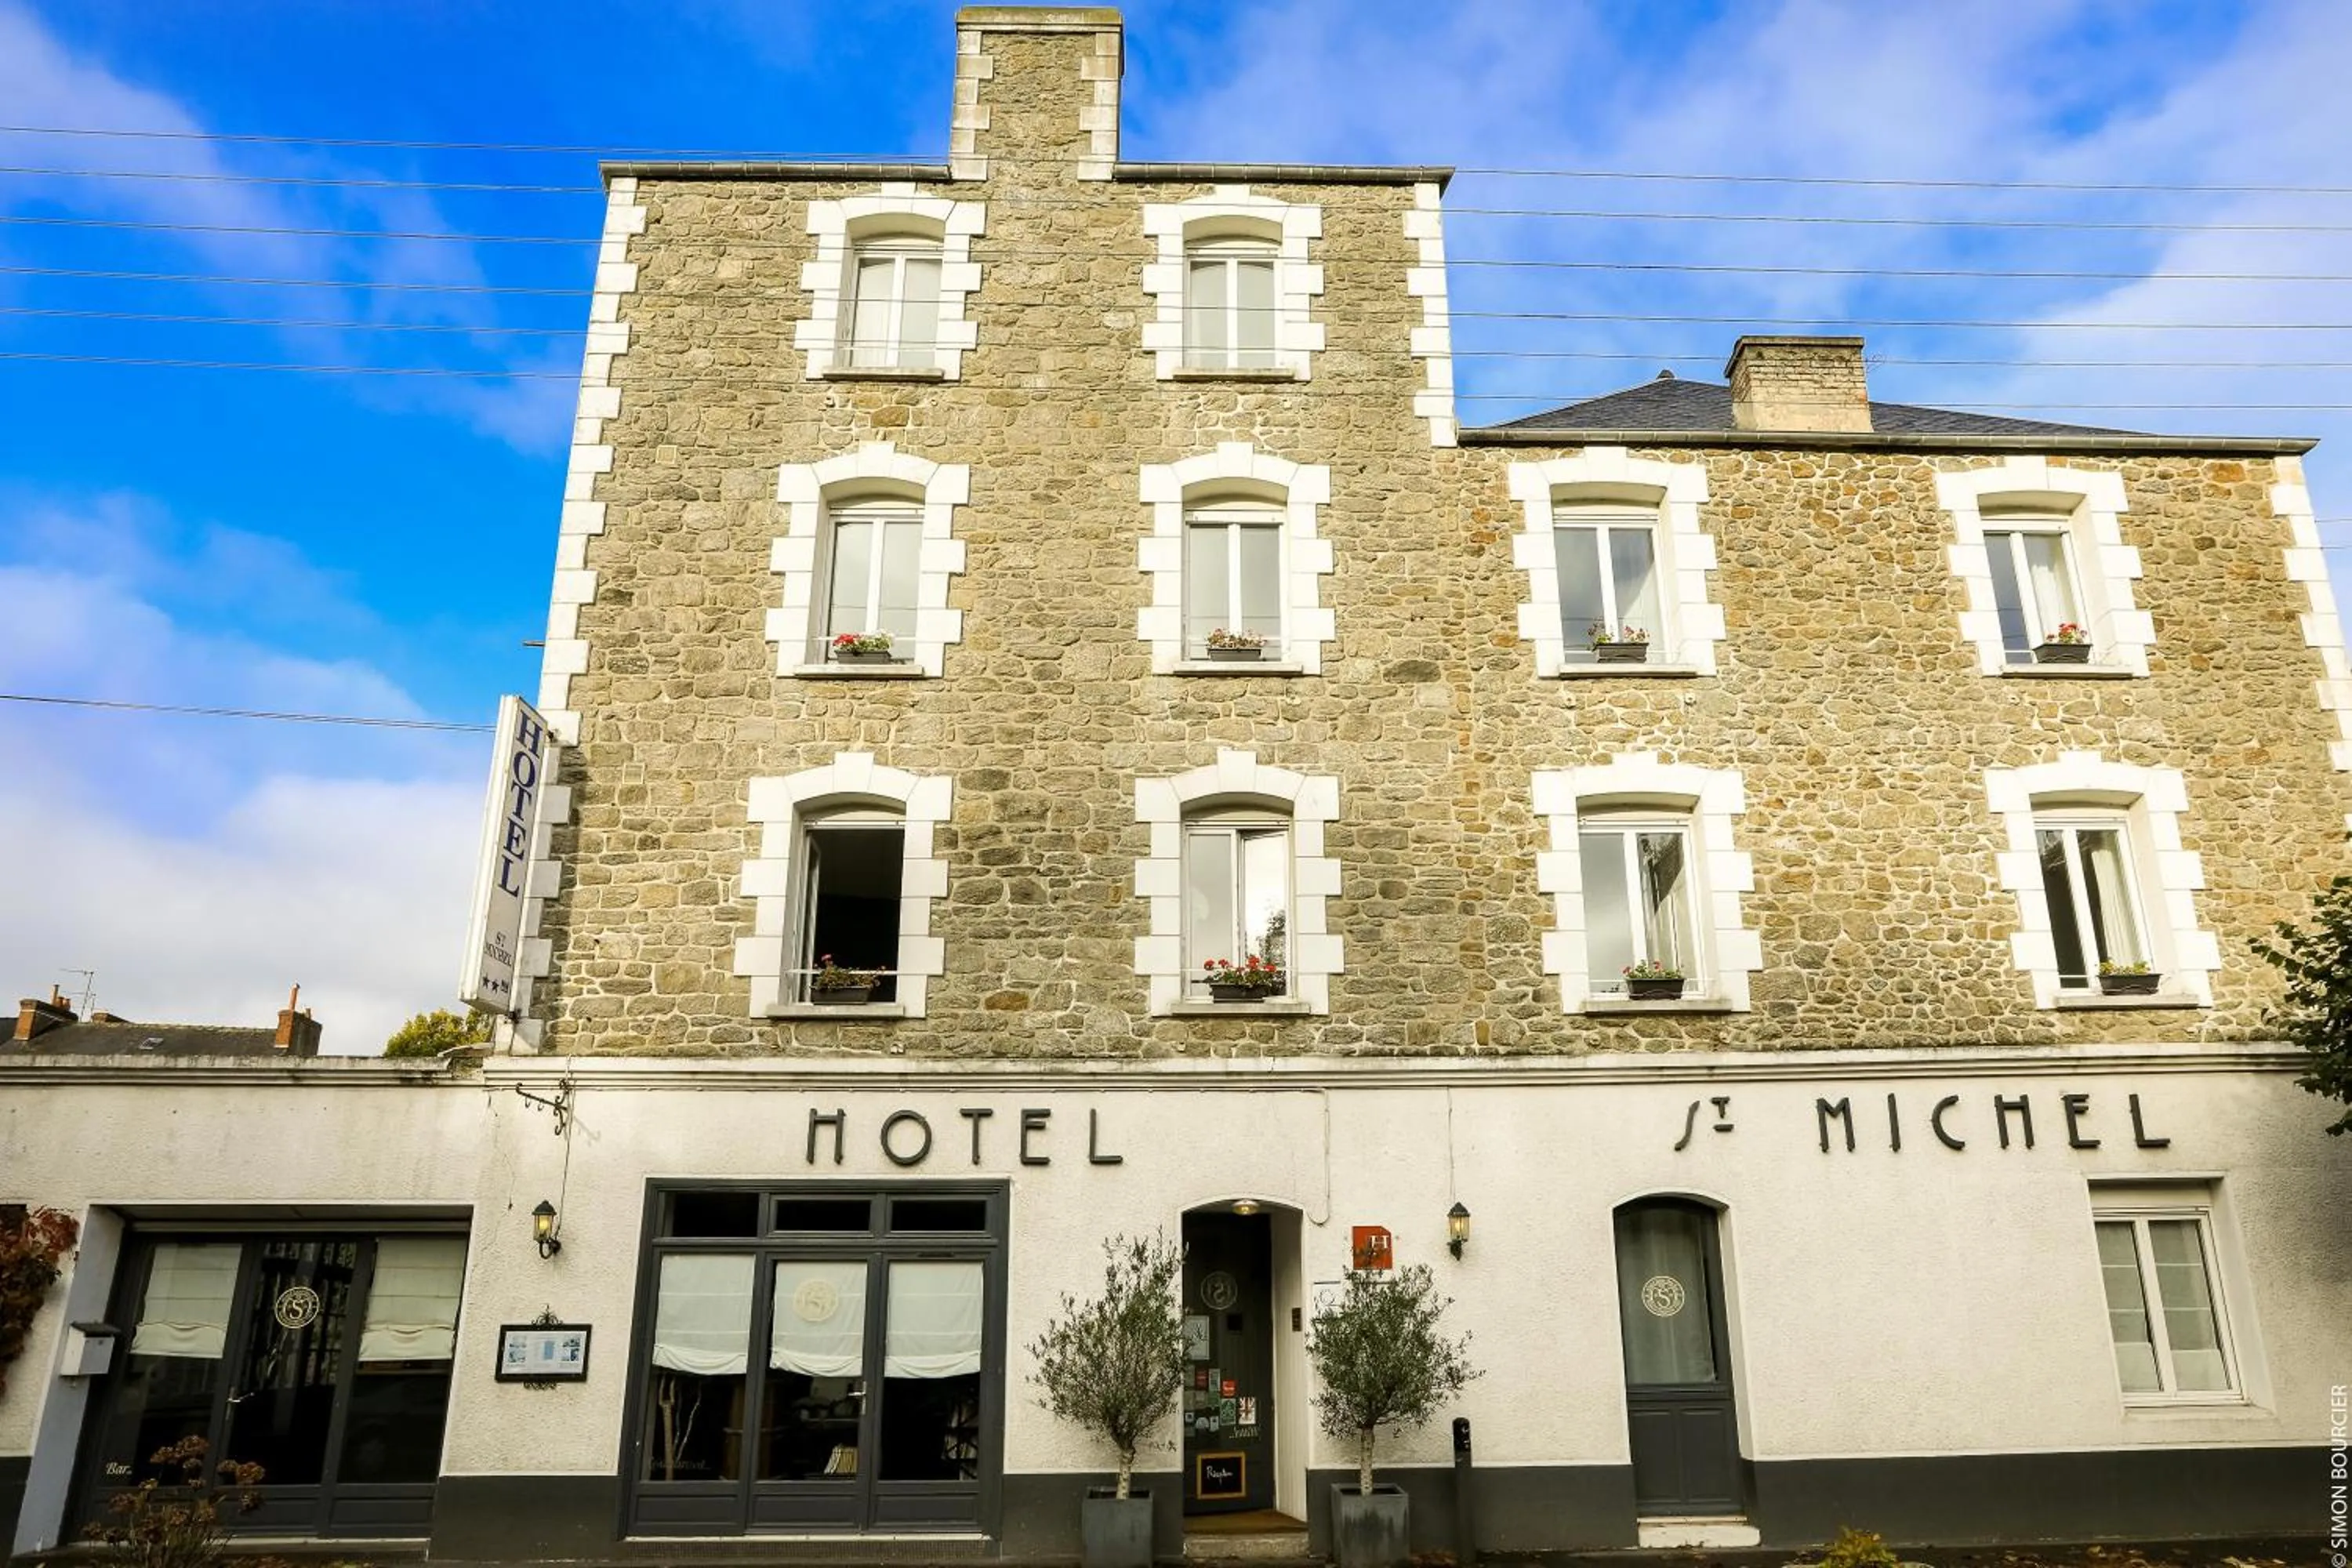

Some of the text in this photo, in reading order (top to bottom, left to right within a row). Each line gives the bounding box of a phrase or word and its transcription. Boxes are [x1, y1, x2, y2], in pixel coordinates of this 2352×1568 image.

[498, 709, 544, 898] HOTEL
[806, 1108, 1123, 1167] HOTEL
[1816, 1093, 2171, 1152] MICHEL
